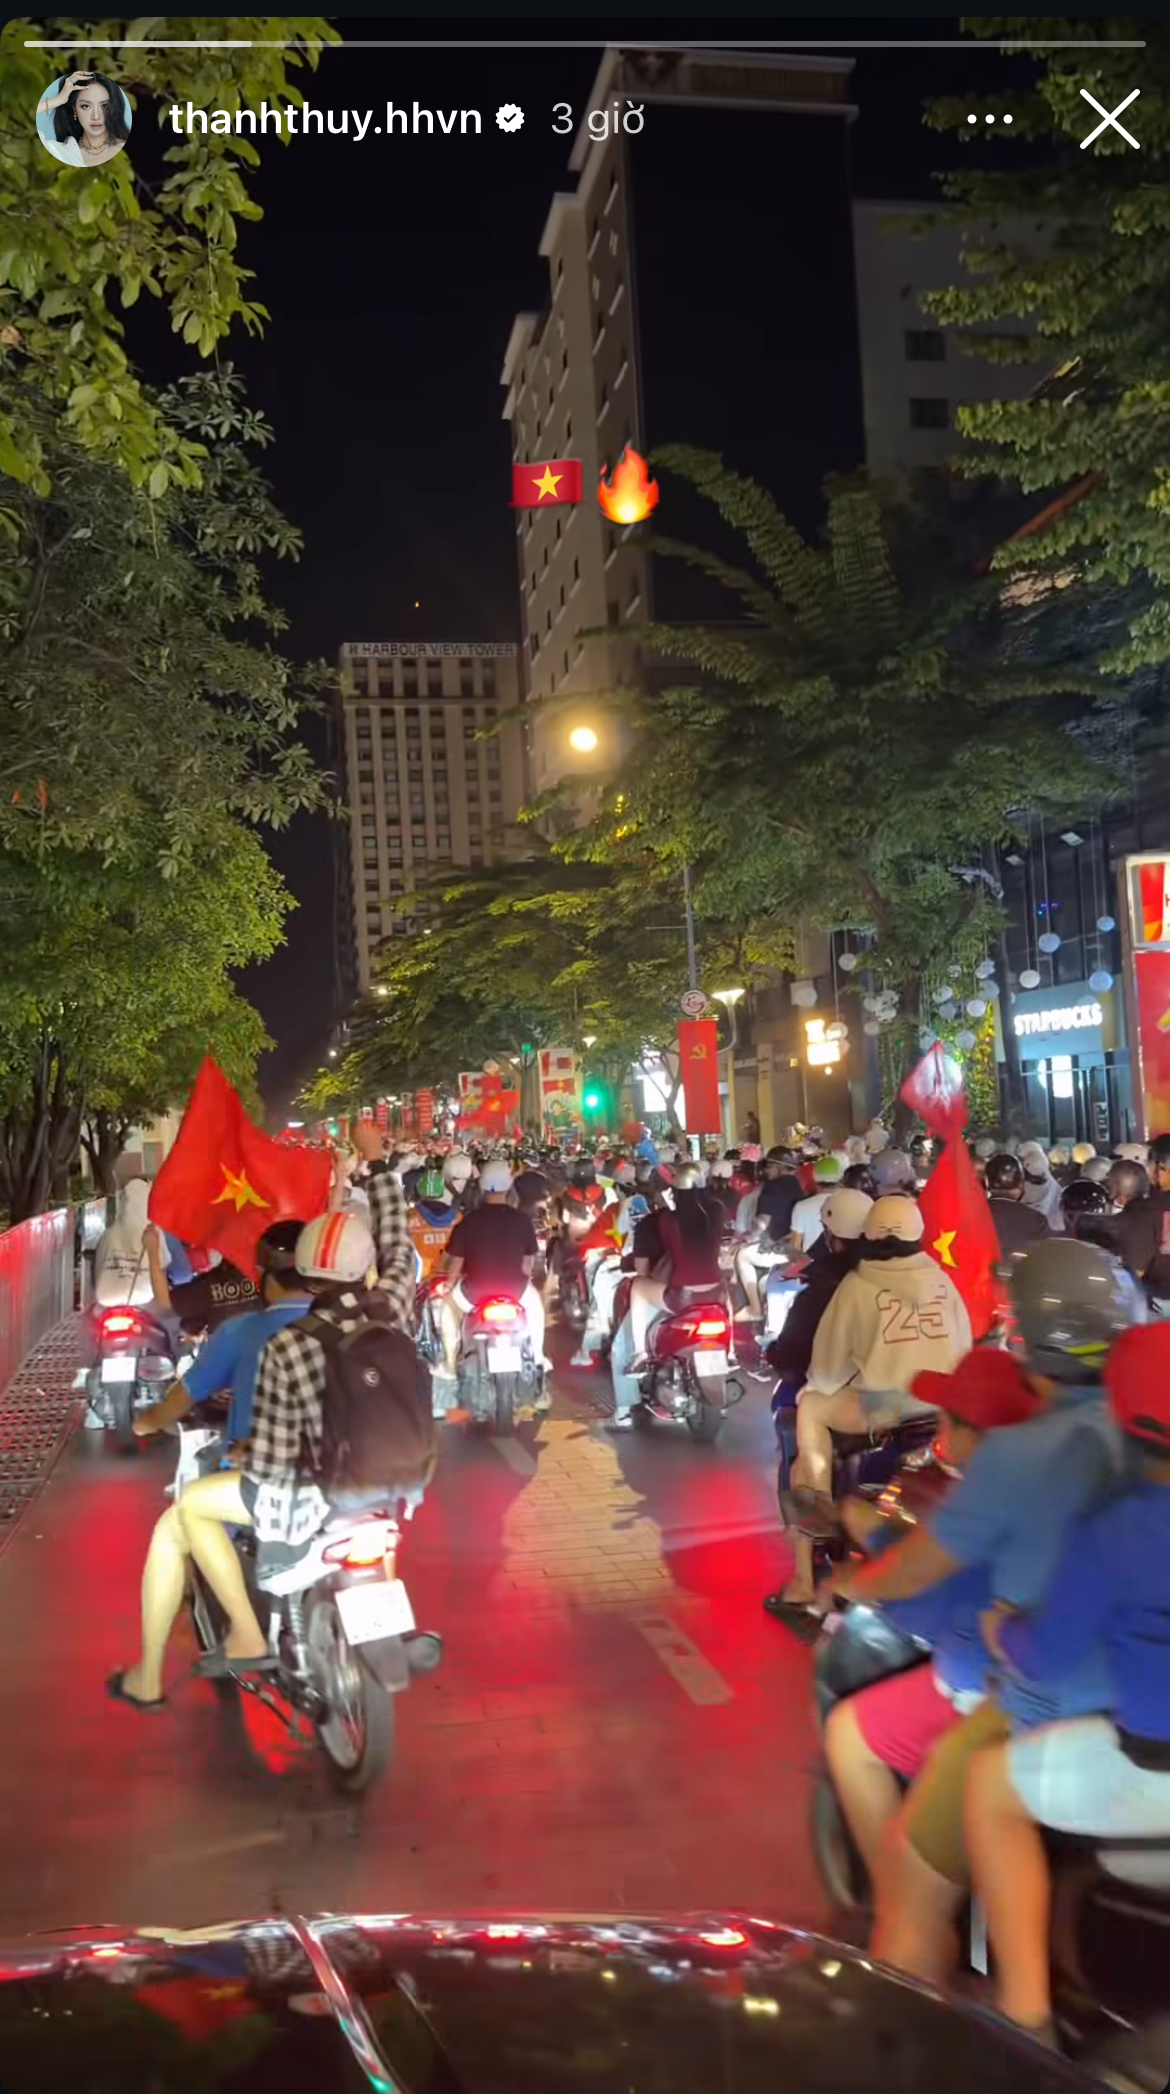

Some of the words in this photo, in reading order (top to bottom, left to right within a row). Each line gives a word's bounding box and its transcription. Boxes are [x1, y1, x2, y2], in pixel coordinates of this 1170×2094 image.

[362, 643, 427, 656] HARBOUR
[430, 643, 462, 656] VIEW
[467, 643, 514, 656] TOWER
[1013, 1002, 1104, 1036] STARBUCKS
[875, 1283, 949, 1345] 25
